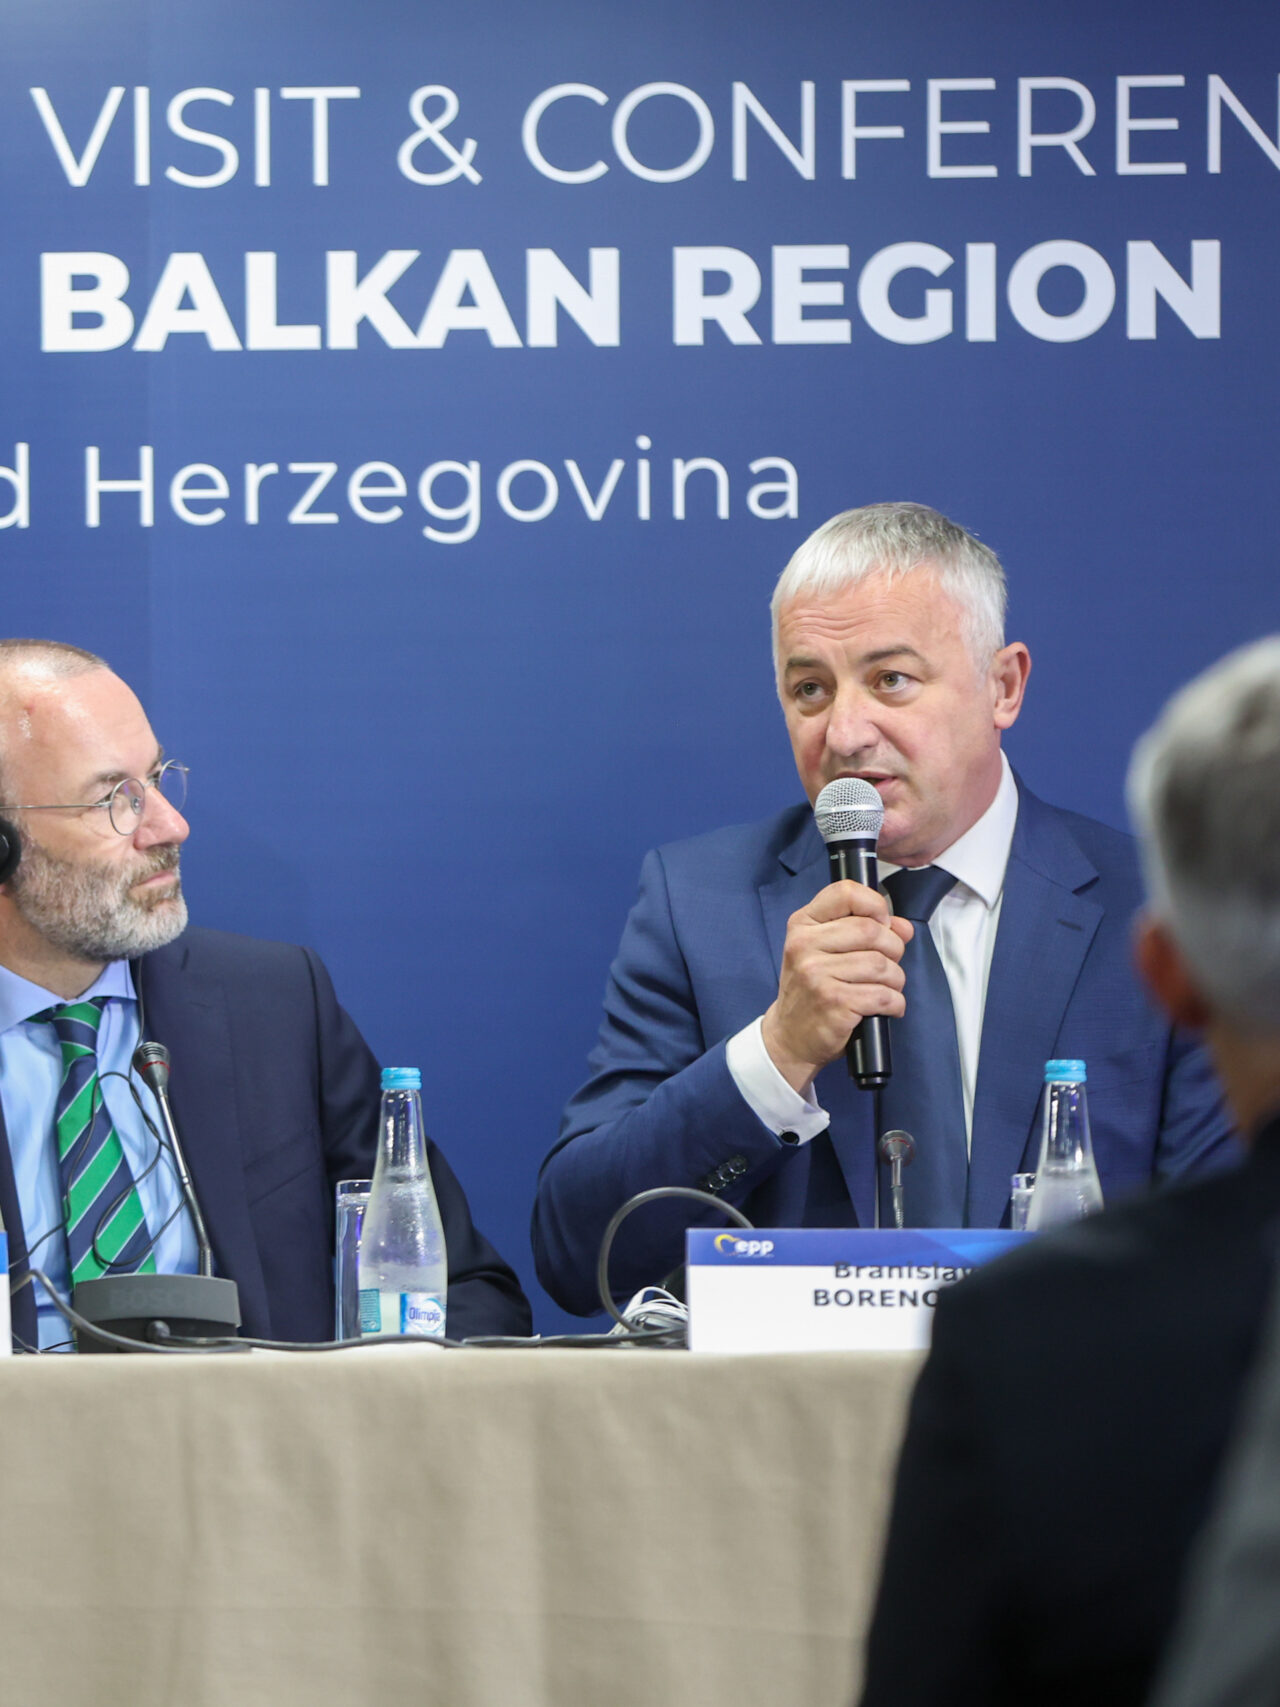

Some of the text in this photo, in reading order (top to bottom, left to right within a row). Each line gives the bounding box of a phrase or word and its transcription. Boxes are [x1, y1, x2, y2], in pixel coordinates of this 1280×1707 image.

[28, 85, 362, 189] VISIT
[396, 83, 484, 186] &
[520, 73, 1280, 185] CONFEREN
[39, 247, 621, 354] BALKAN
[671, 238, 1222, 347] REGION
[84, 433, 800, 546] Herzegovina
[734, 1240, 775, 1257] epp
